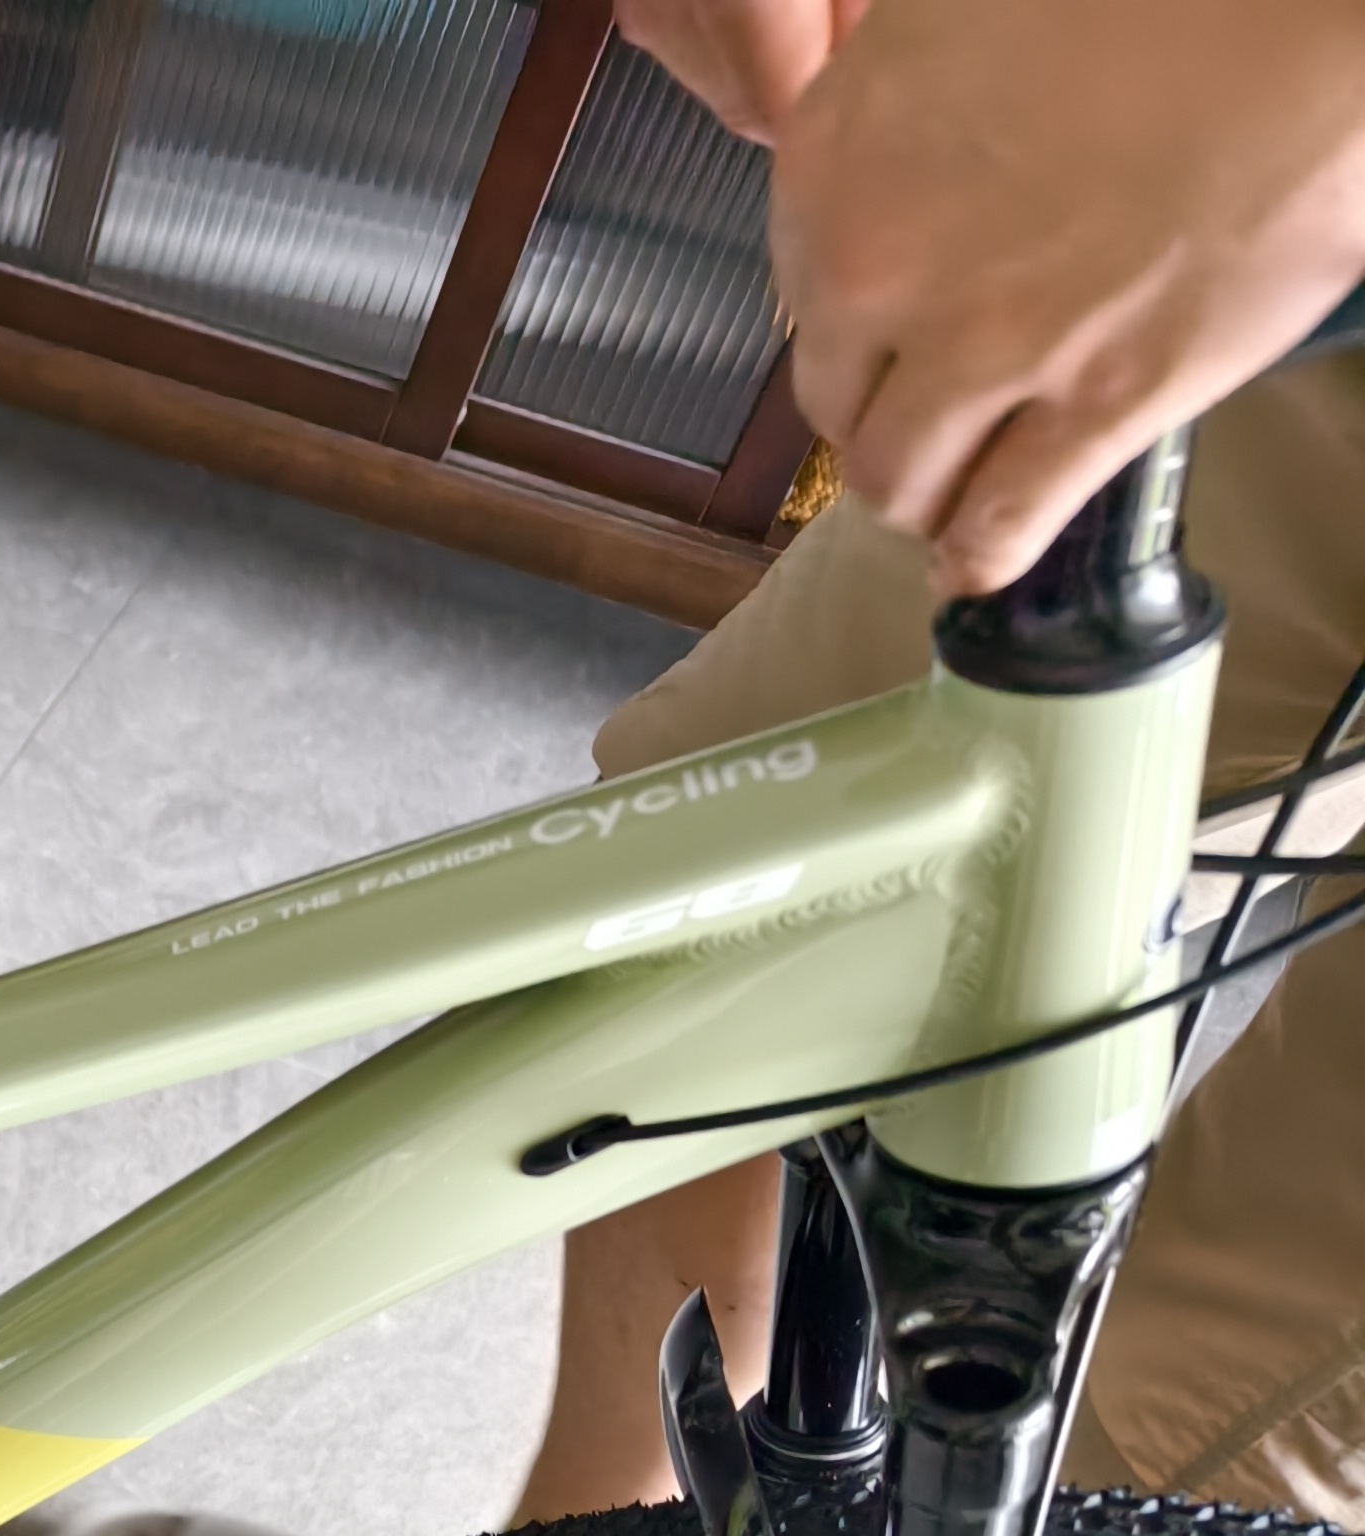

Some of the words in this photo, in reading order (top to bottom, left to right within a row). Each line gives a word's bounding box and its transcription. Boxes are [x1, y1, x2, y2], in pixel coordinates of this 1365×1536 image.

[171, 917, 258, 955] LEAD
[275, 889, 341, 921] THE
[357, 836, 512, 894] FASHION
[529, 738, 818, 844] Cycling
